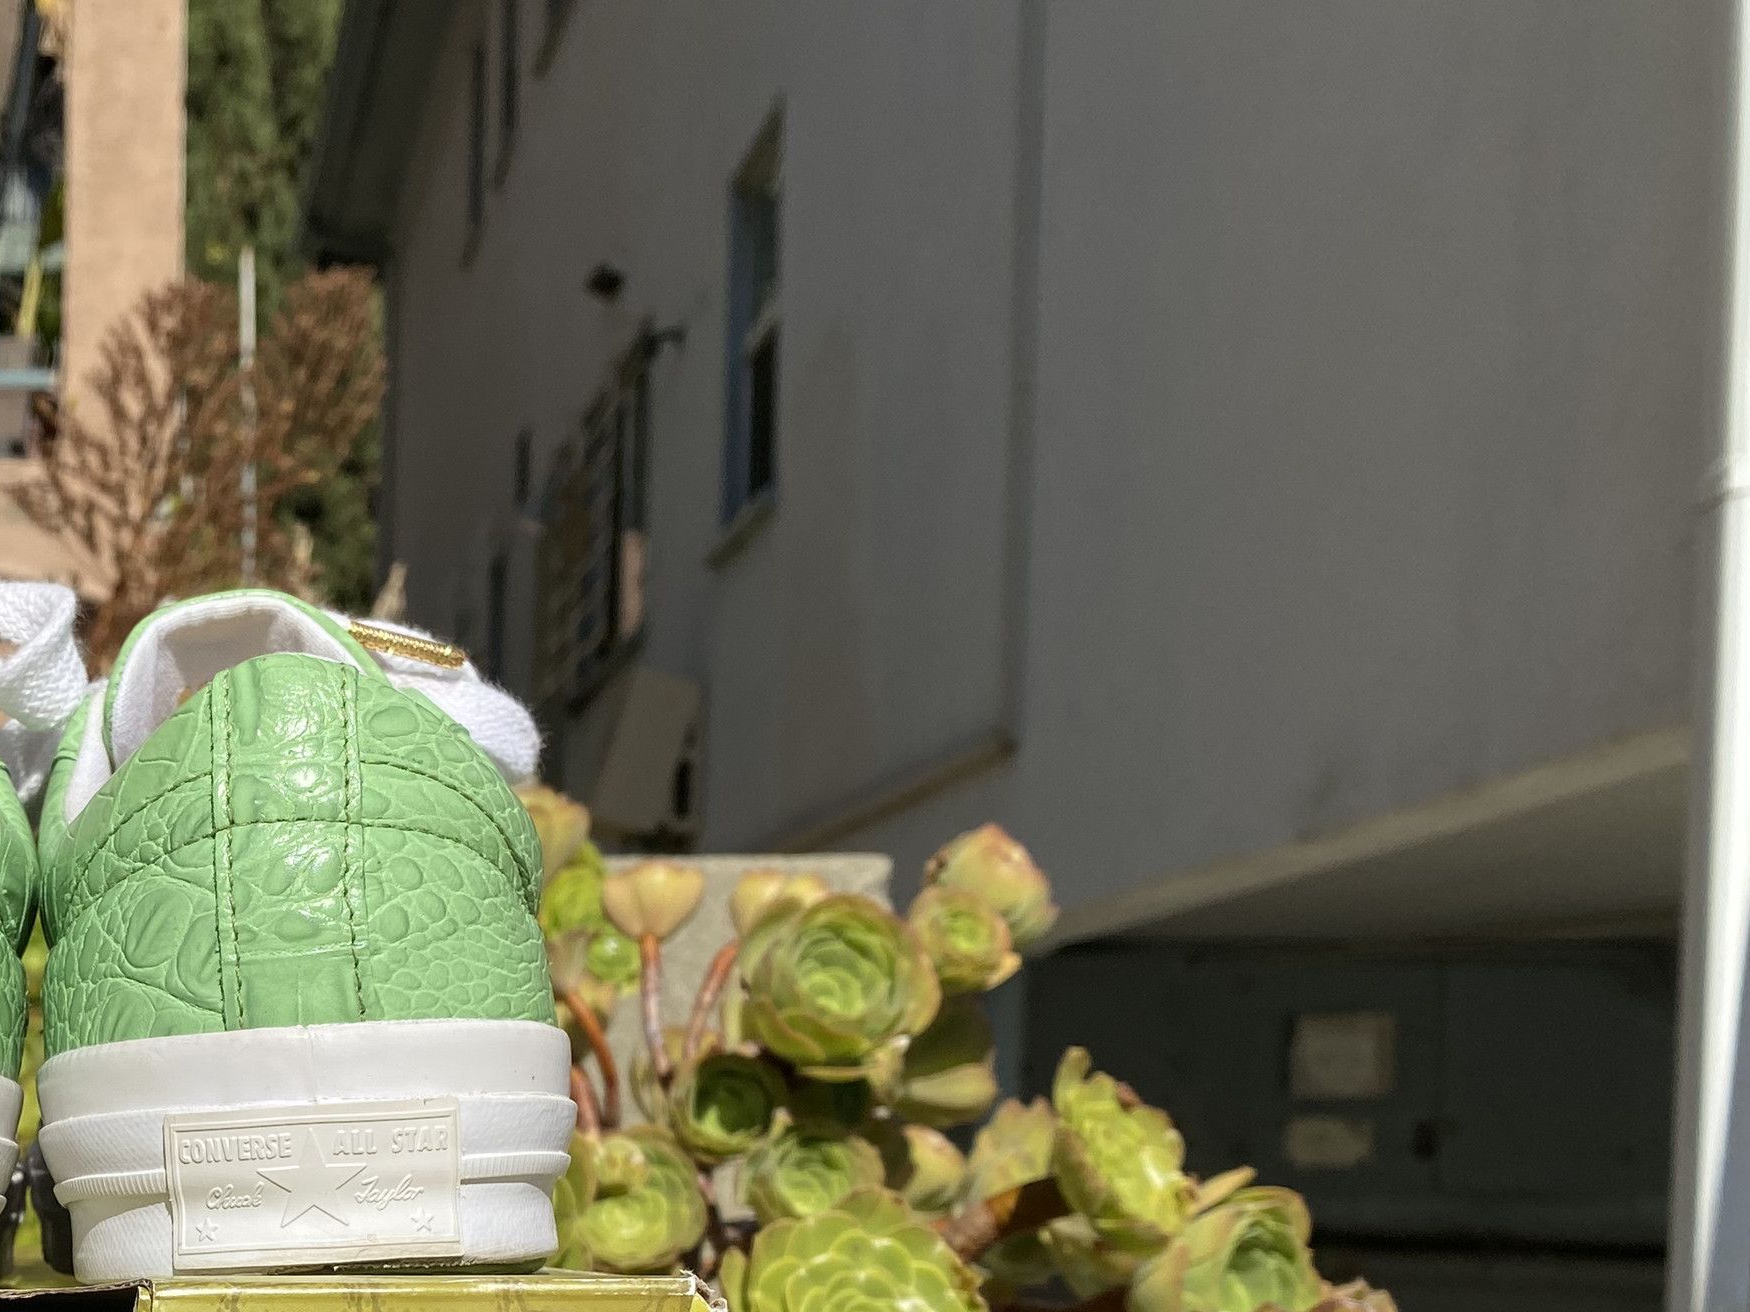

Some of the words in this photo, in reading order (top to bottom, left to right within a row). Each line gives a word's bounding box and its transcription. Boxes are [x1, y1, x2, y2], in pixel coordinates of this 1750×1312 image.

[178, 1131, 293, 1165] CONVERSE
[332, 1127, 378, 1156] ALL
[391, 1125, 450, 1154] STAR
[205, 1180, 266, 1210] Chuck
[353, 1173, 425, 1211] Taylor
